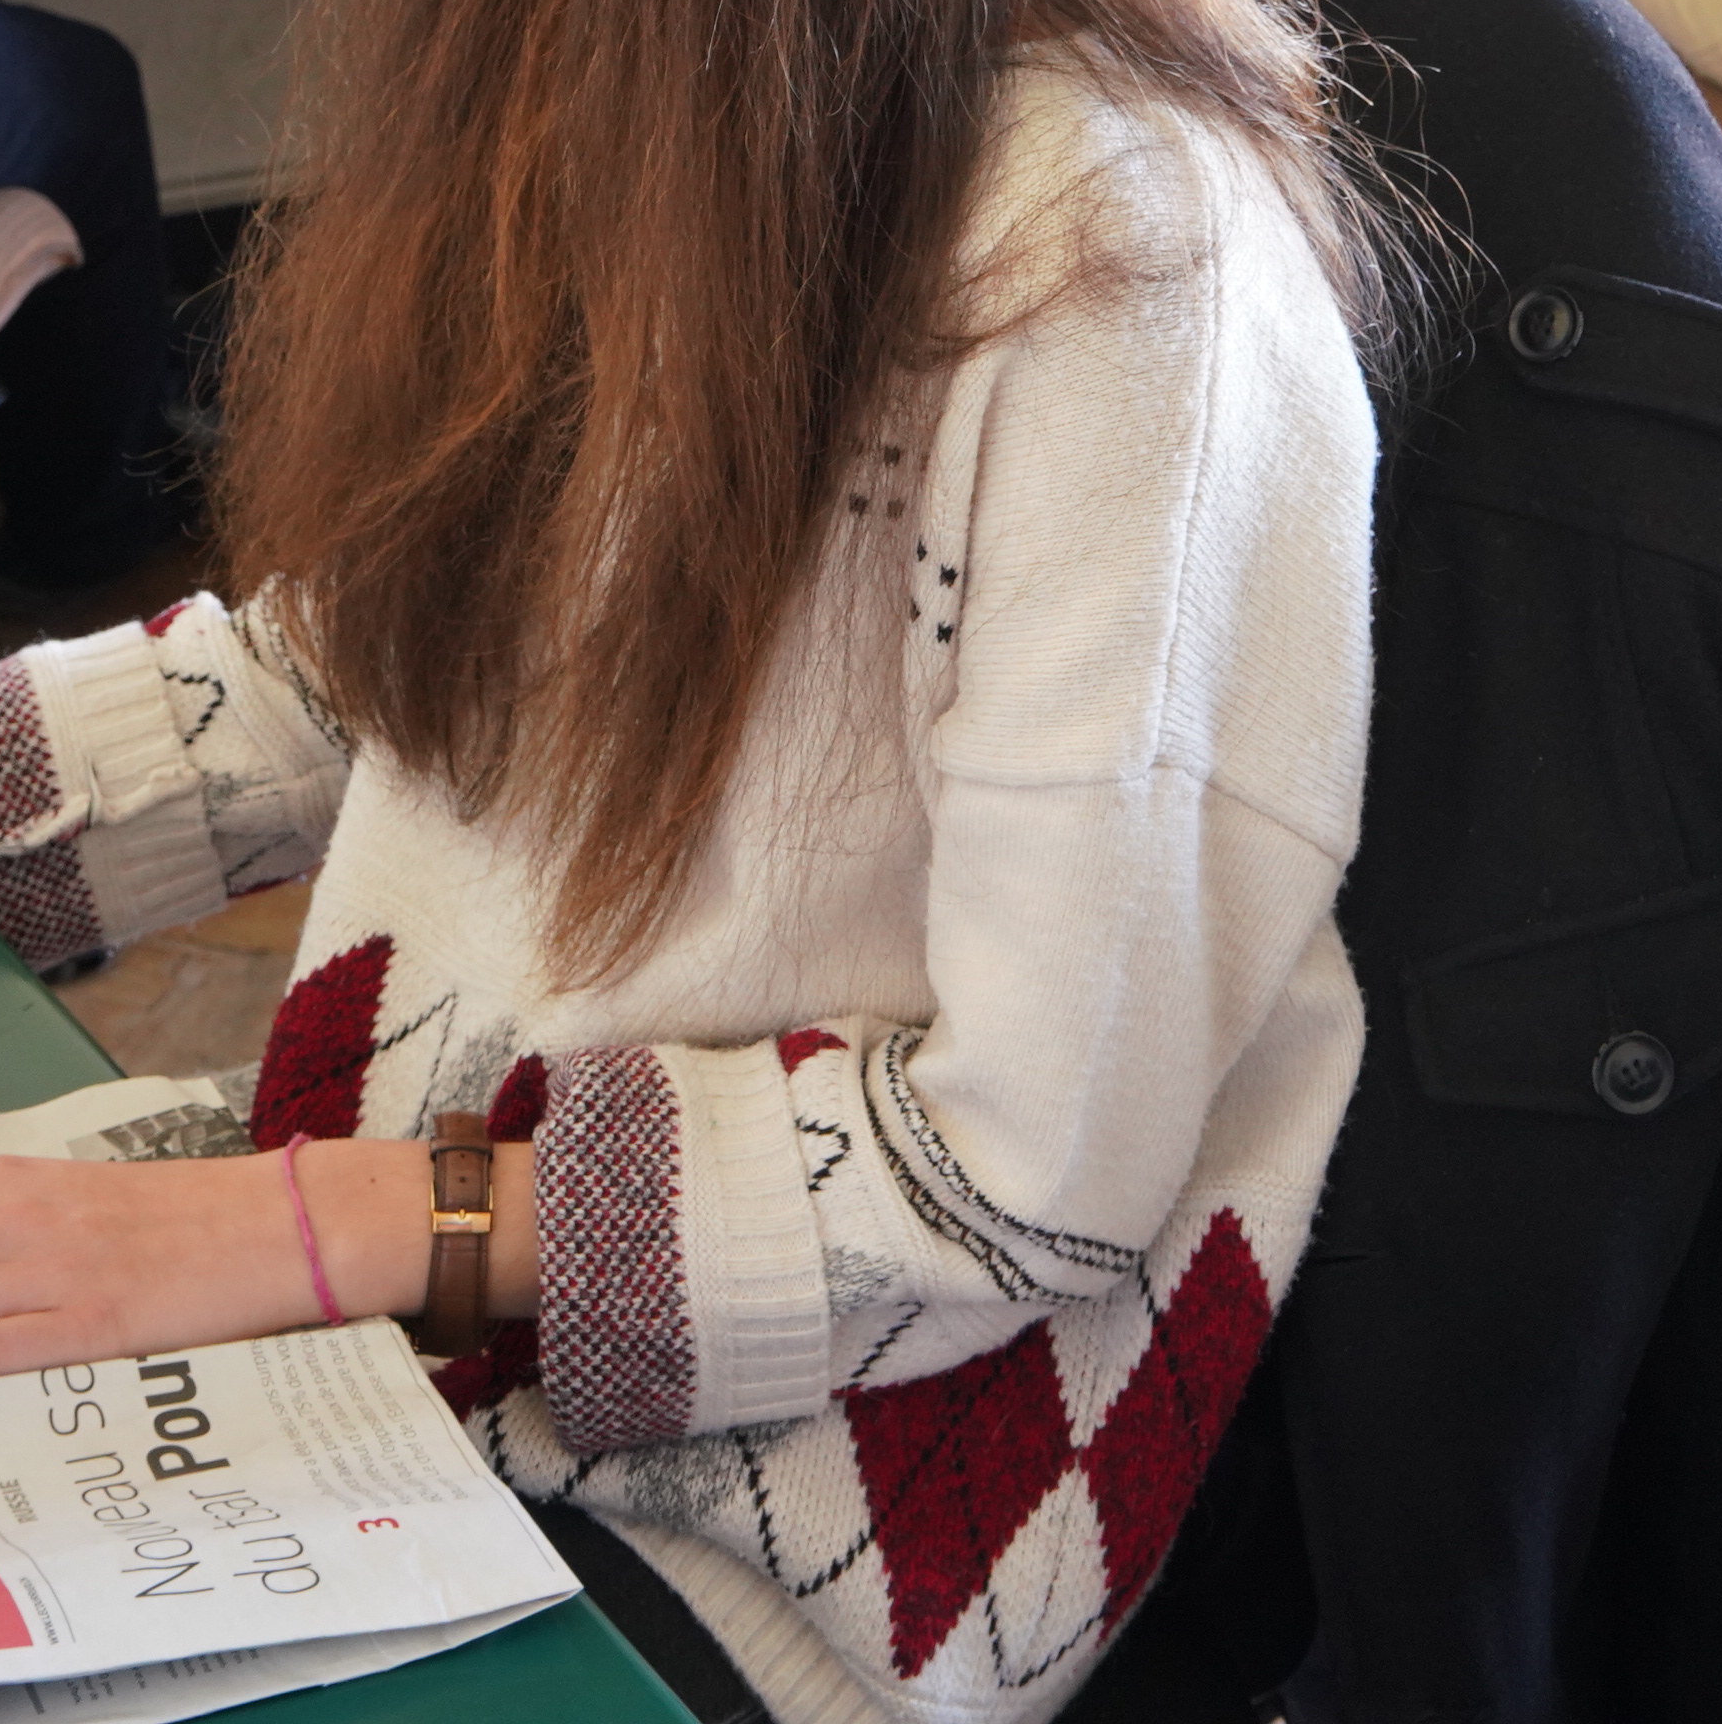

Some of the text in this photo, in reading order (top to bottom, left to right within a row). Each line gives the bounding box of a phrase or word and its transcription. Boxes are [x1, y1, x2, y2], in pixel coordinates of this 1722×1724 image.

[283, 1362, 302, 1389] des
[135, 1356, 321, 1594] du tsar Pou
[66, 1451, 215, 1599] Nouveau
[357, 1516, 400, 1534] 3
